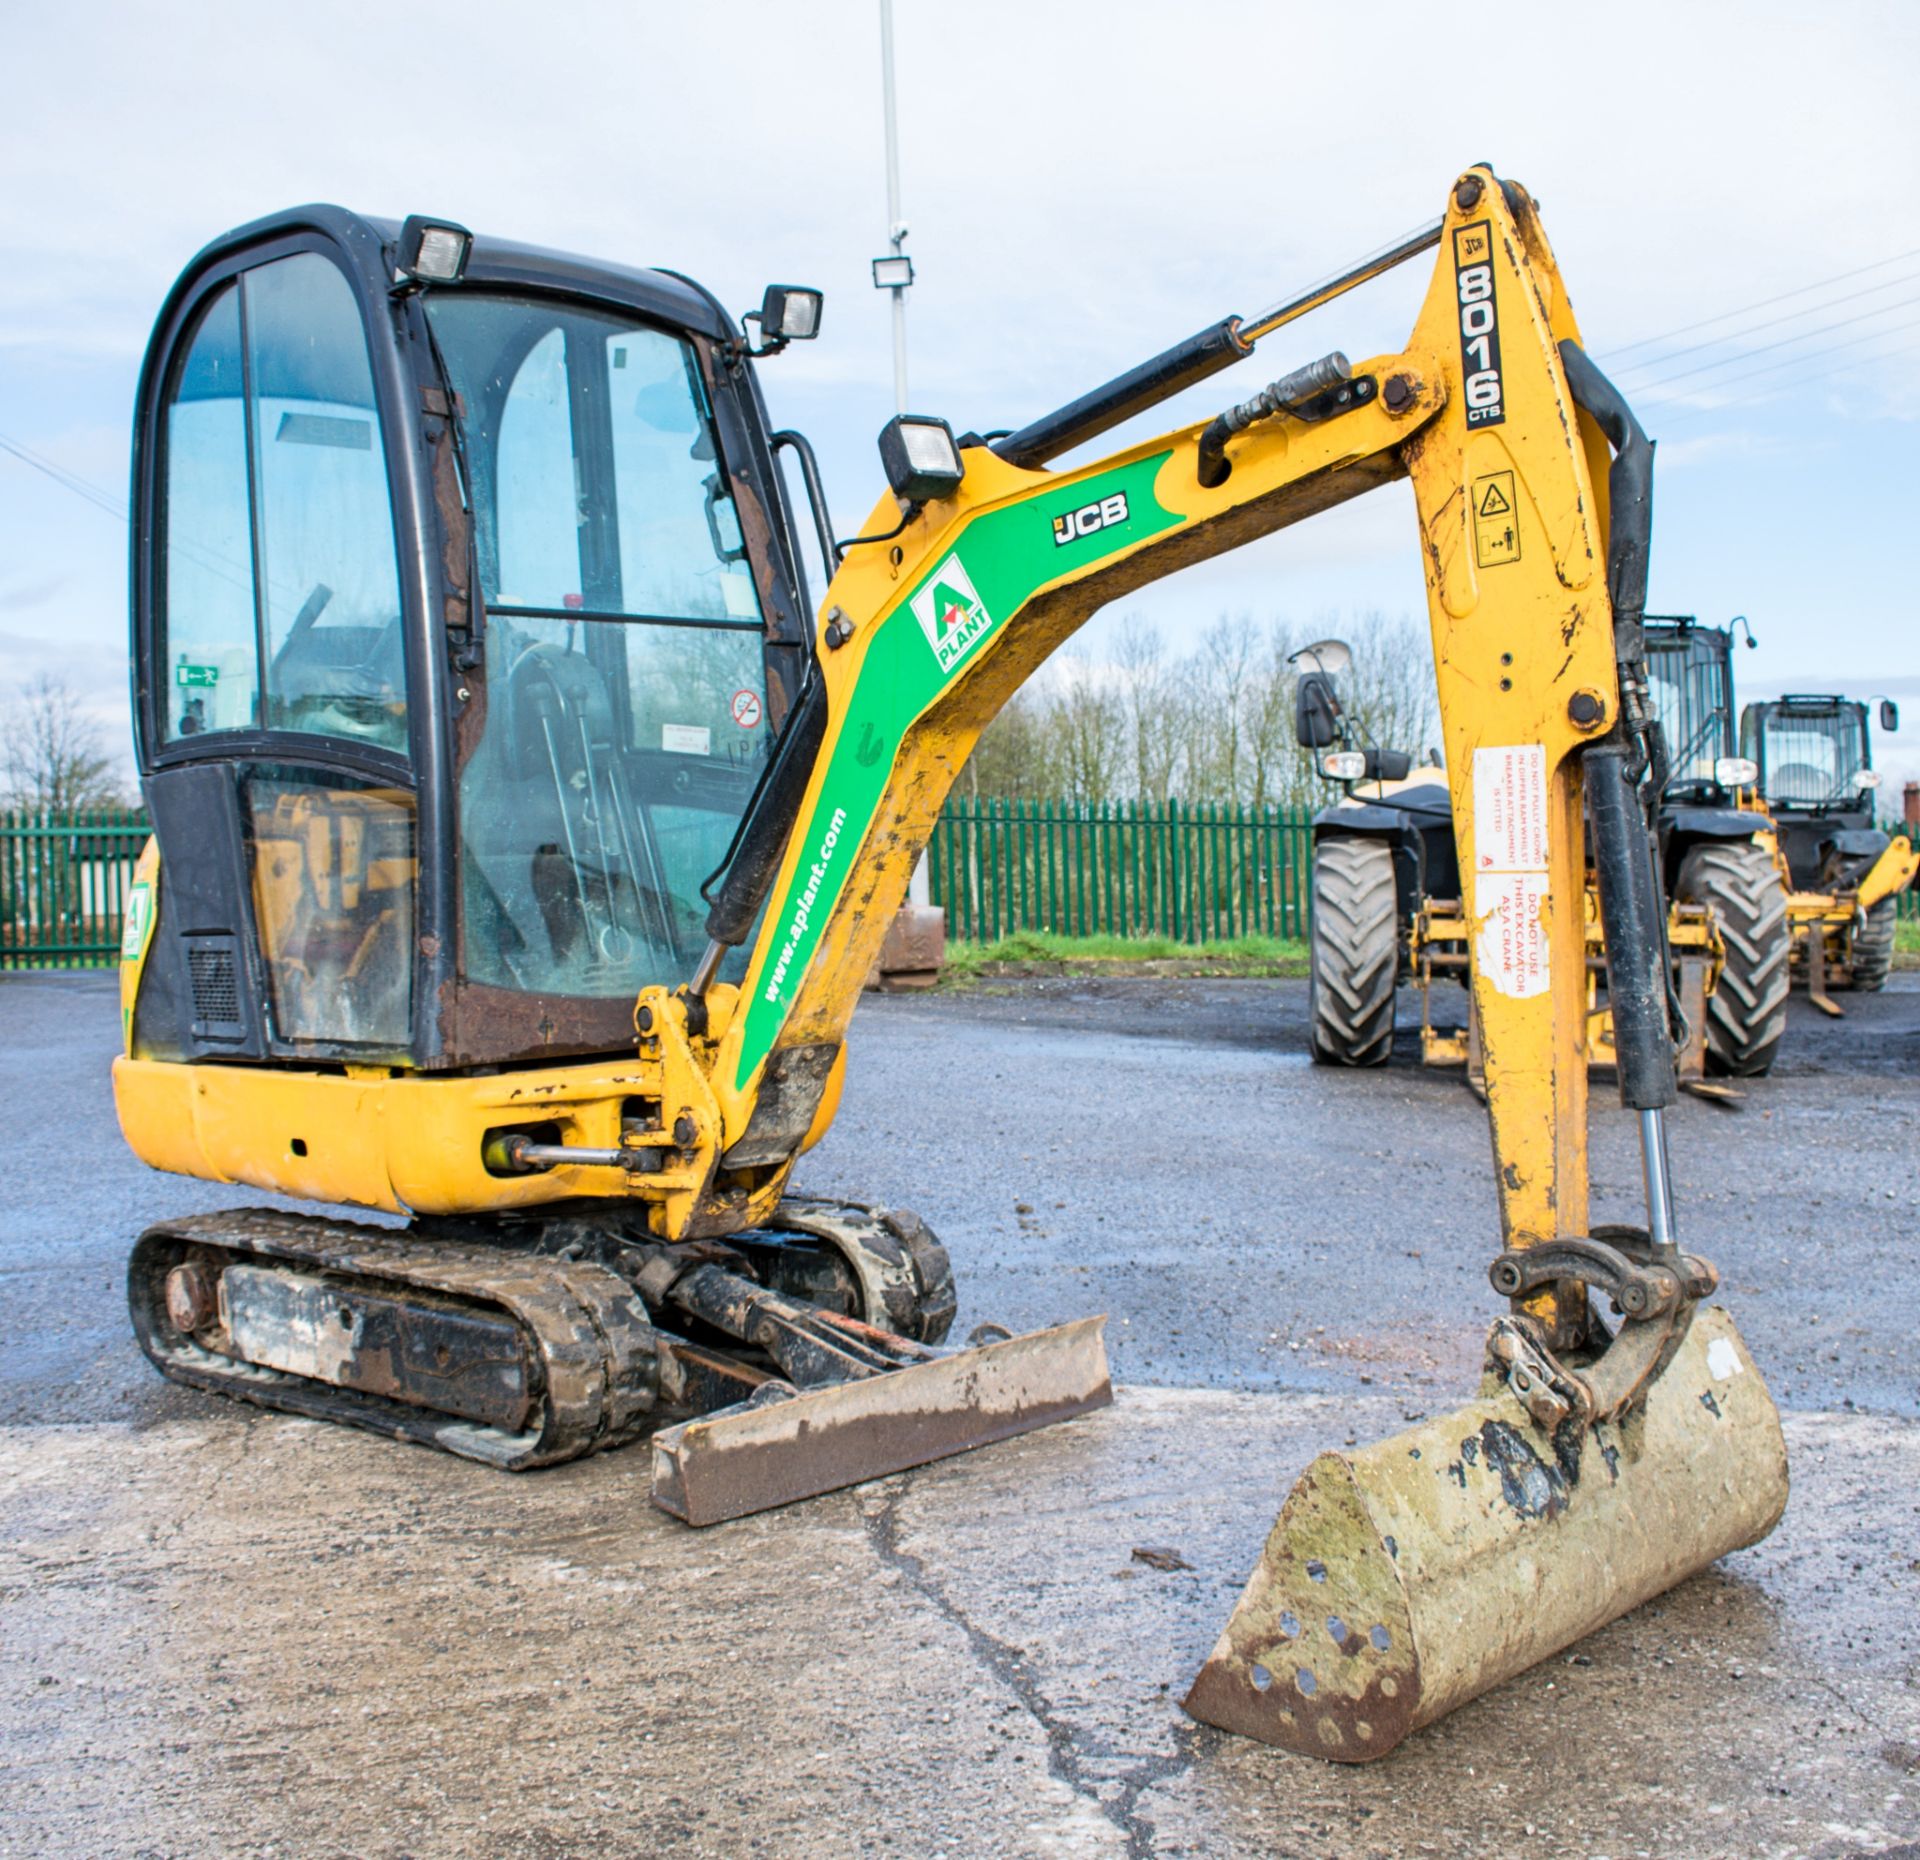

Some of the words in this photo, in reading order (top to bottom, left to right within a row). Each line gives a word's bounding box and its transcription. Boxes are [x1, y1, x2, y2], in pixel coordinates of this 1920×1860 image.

[1466, 236, 1484, 256] JCB
[1458, 265, 1501, 409] 8016
[1468, 404, 1501, 422] CTS
[1055, 493, 1129, 544] JCB
[933, 580, 975, 642] A
[938, 608, 987, 666] PLANT
[1518, 755, 1525, 765] IN
[1531, 753, 1538, 768] DO
[1505, 755, 1514, 796] BREAKER
[1518, 768, 1526, 802] DIPPER
[1531, 771, 1539, 789] NOT
[1494, 788, 1500, 796] IS
[1532, 792, 1540, 822] FULLY
[1494, 799, 1502, 833] FITTED
[1519, 804, 1527, 825] RAM
[1507, 798, 1515, 864] ATTACHMENT
[1520, 825, 1528, 864] WHILST
[1533, 827, 1541, 864] CROWD
[764, 807, 847, 1002] www.aplant.com
[1502, 895, 1510, 912] AS
[1515, 879, 1524, 908] THIS
[1528, 893, 1537, 914] DO
[1503, 915, 1510, 924] A
[1528, 919, 1538, 945] NOT
[1503, 929, 1511, 974] CRANE
[1515, 912, 1525, 992] EXCAVATOR
[1529, 952, 1538, 976] USE
